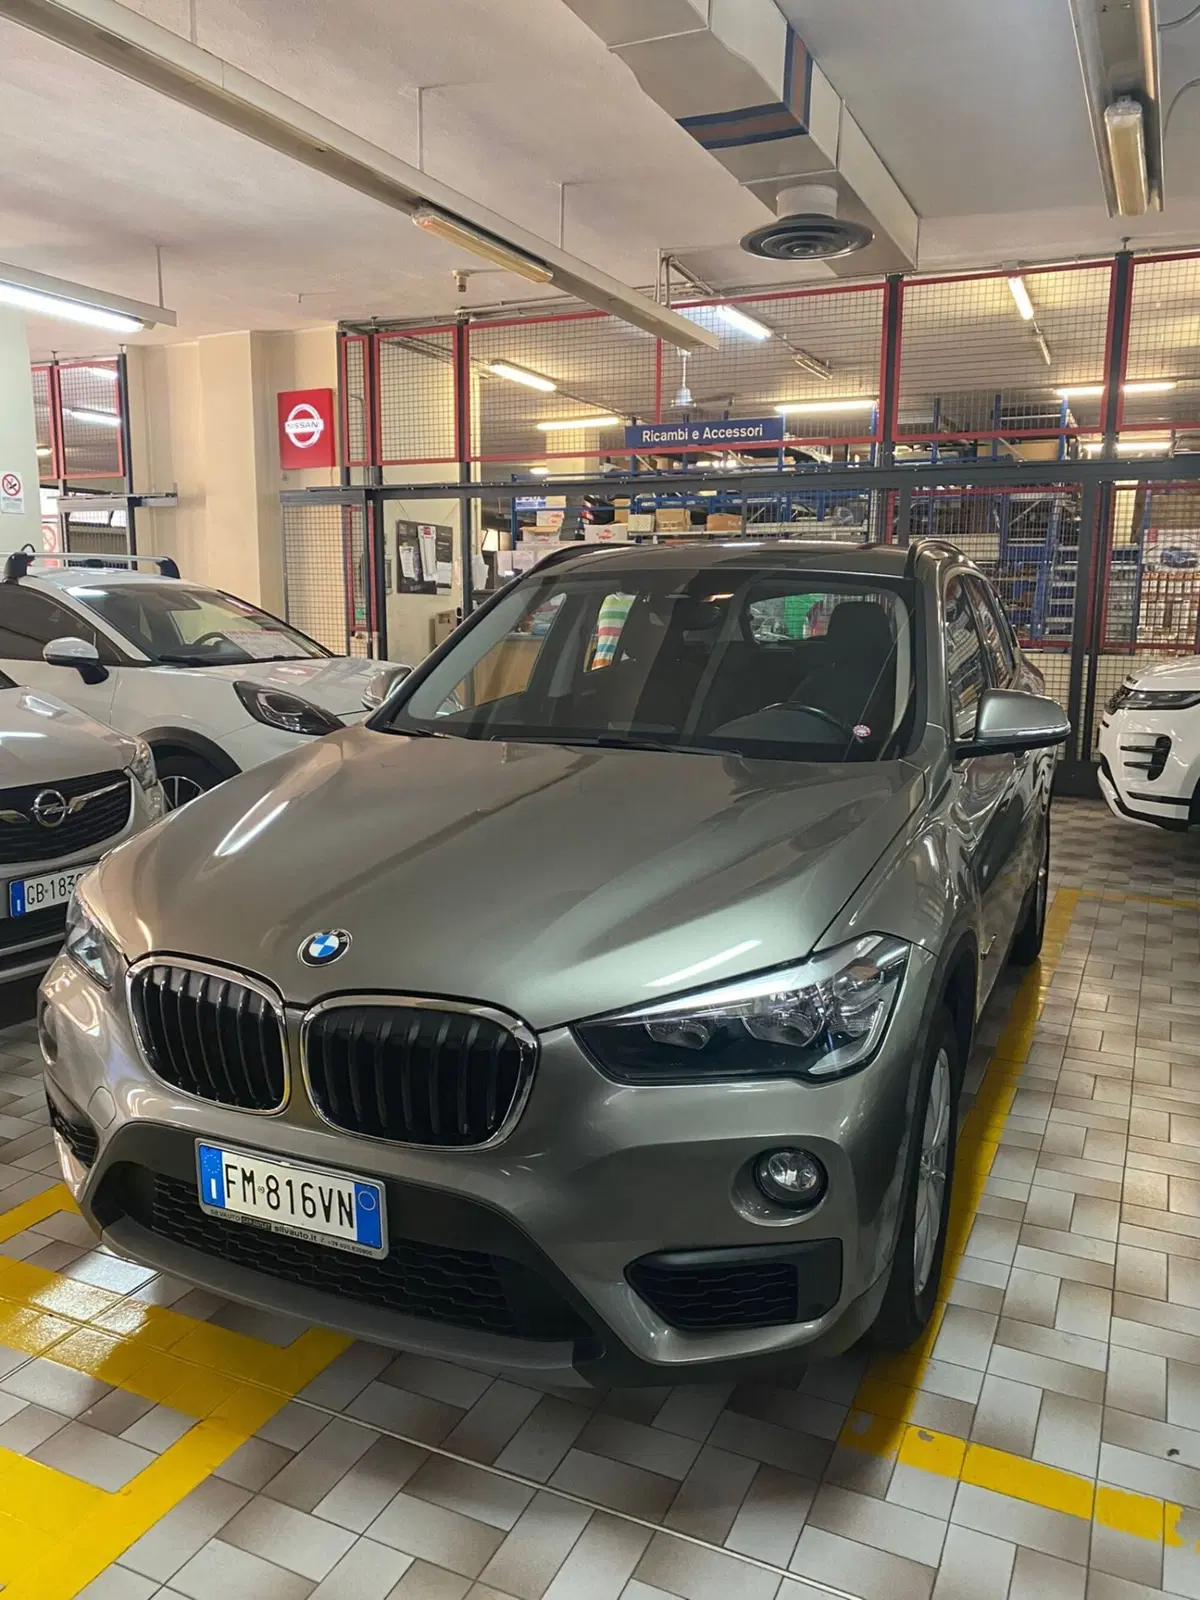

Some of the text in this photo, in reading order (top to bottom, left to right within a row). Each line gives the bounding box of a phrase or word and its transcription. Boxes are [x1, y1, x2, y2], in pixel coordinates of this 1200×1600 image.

[287, 421, 319, 430] NISSAN
[642, 424, 763, 442] Ricambi e Accessori
